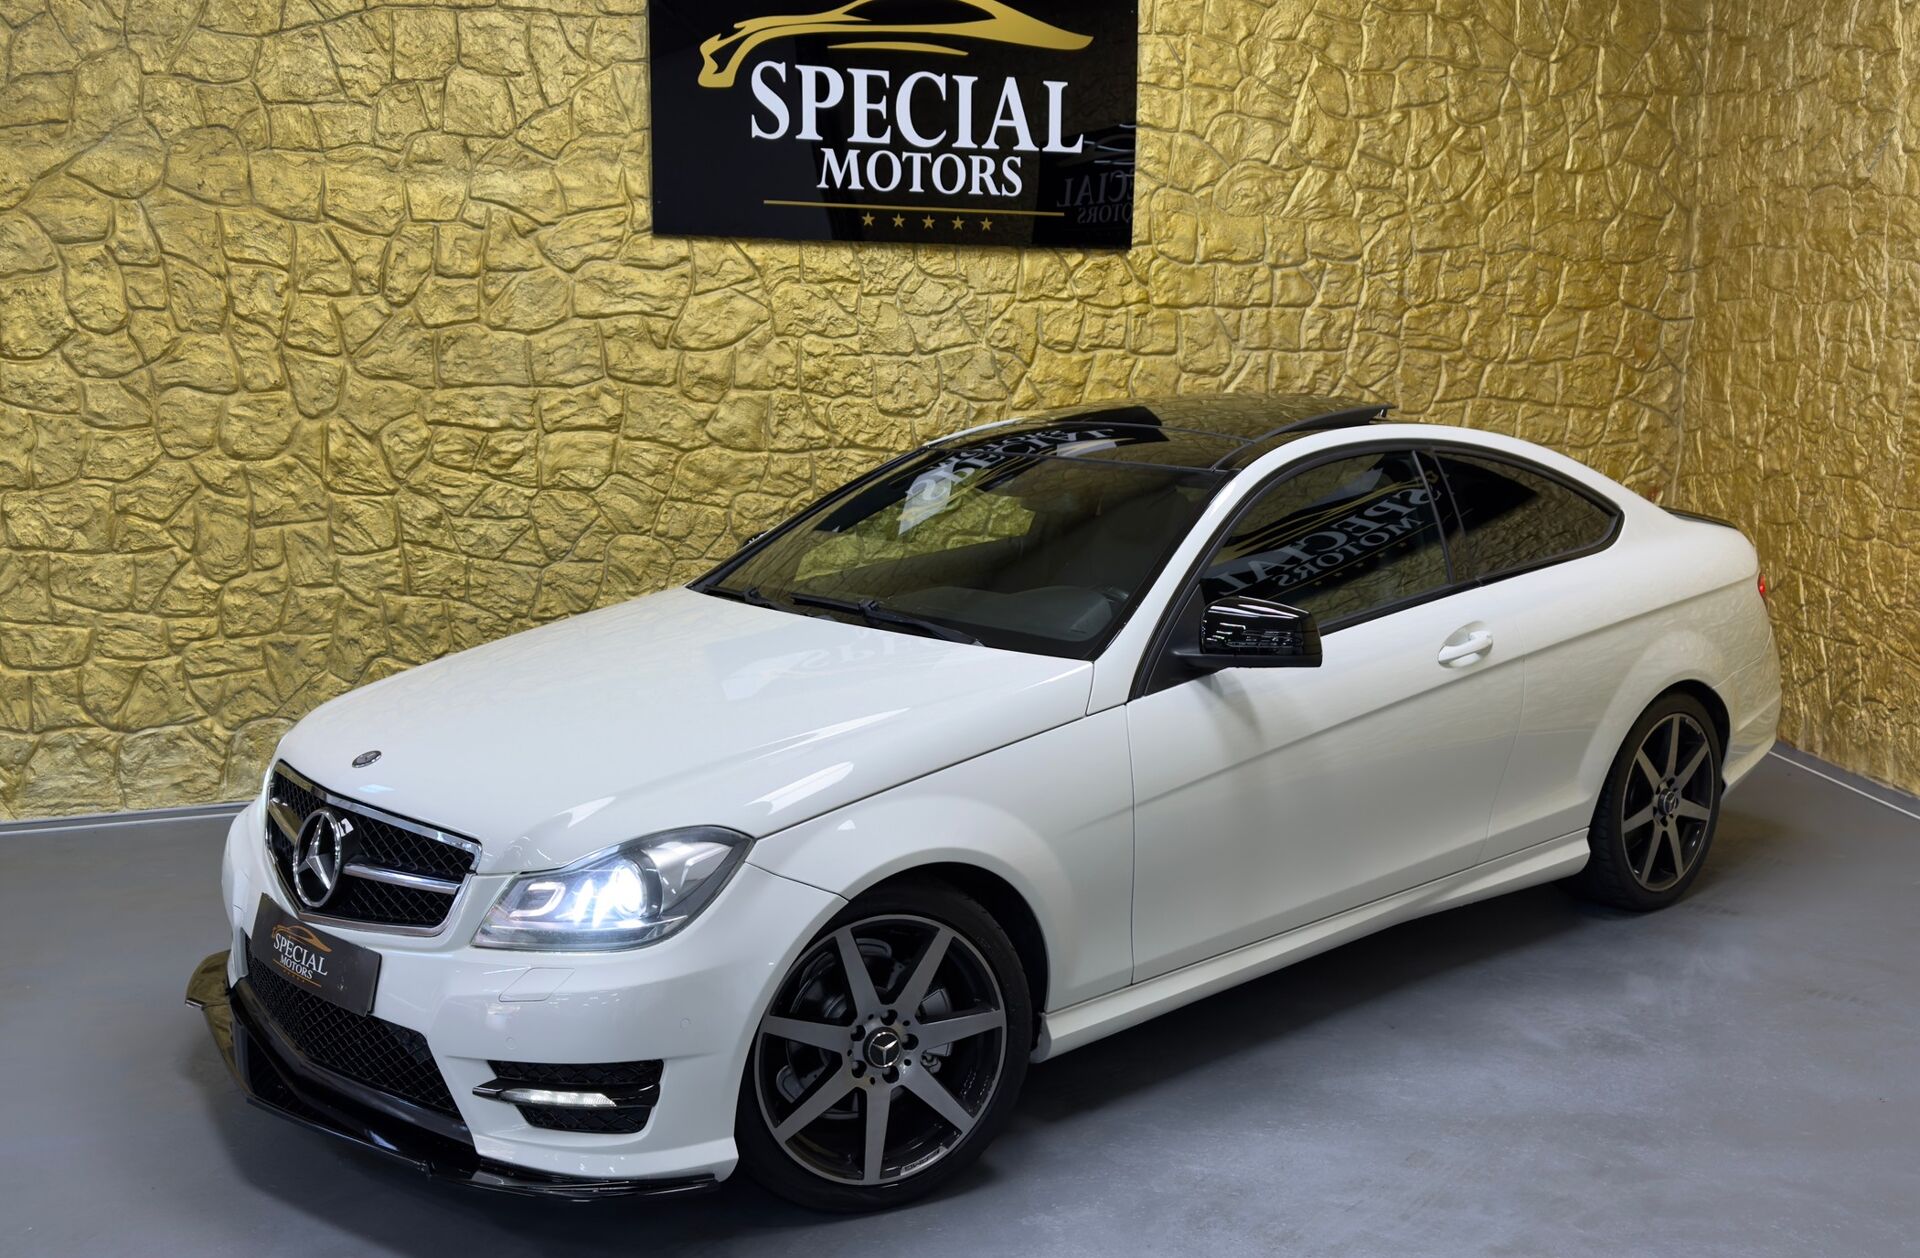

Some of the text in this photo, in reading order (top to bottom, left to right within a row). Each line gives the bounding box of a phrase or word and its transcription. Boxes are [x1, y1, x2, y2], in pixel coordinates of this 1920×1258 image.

[751, 61, 1084, 154] SPECIAL
[817, 148, 1023, 197] MOTORS
[273, 933, 328, 976] SPECIAL
[281, 954, 313, 980] MOTORS
